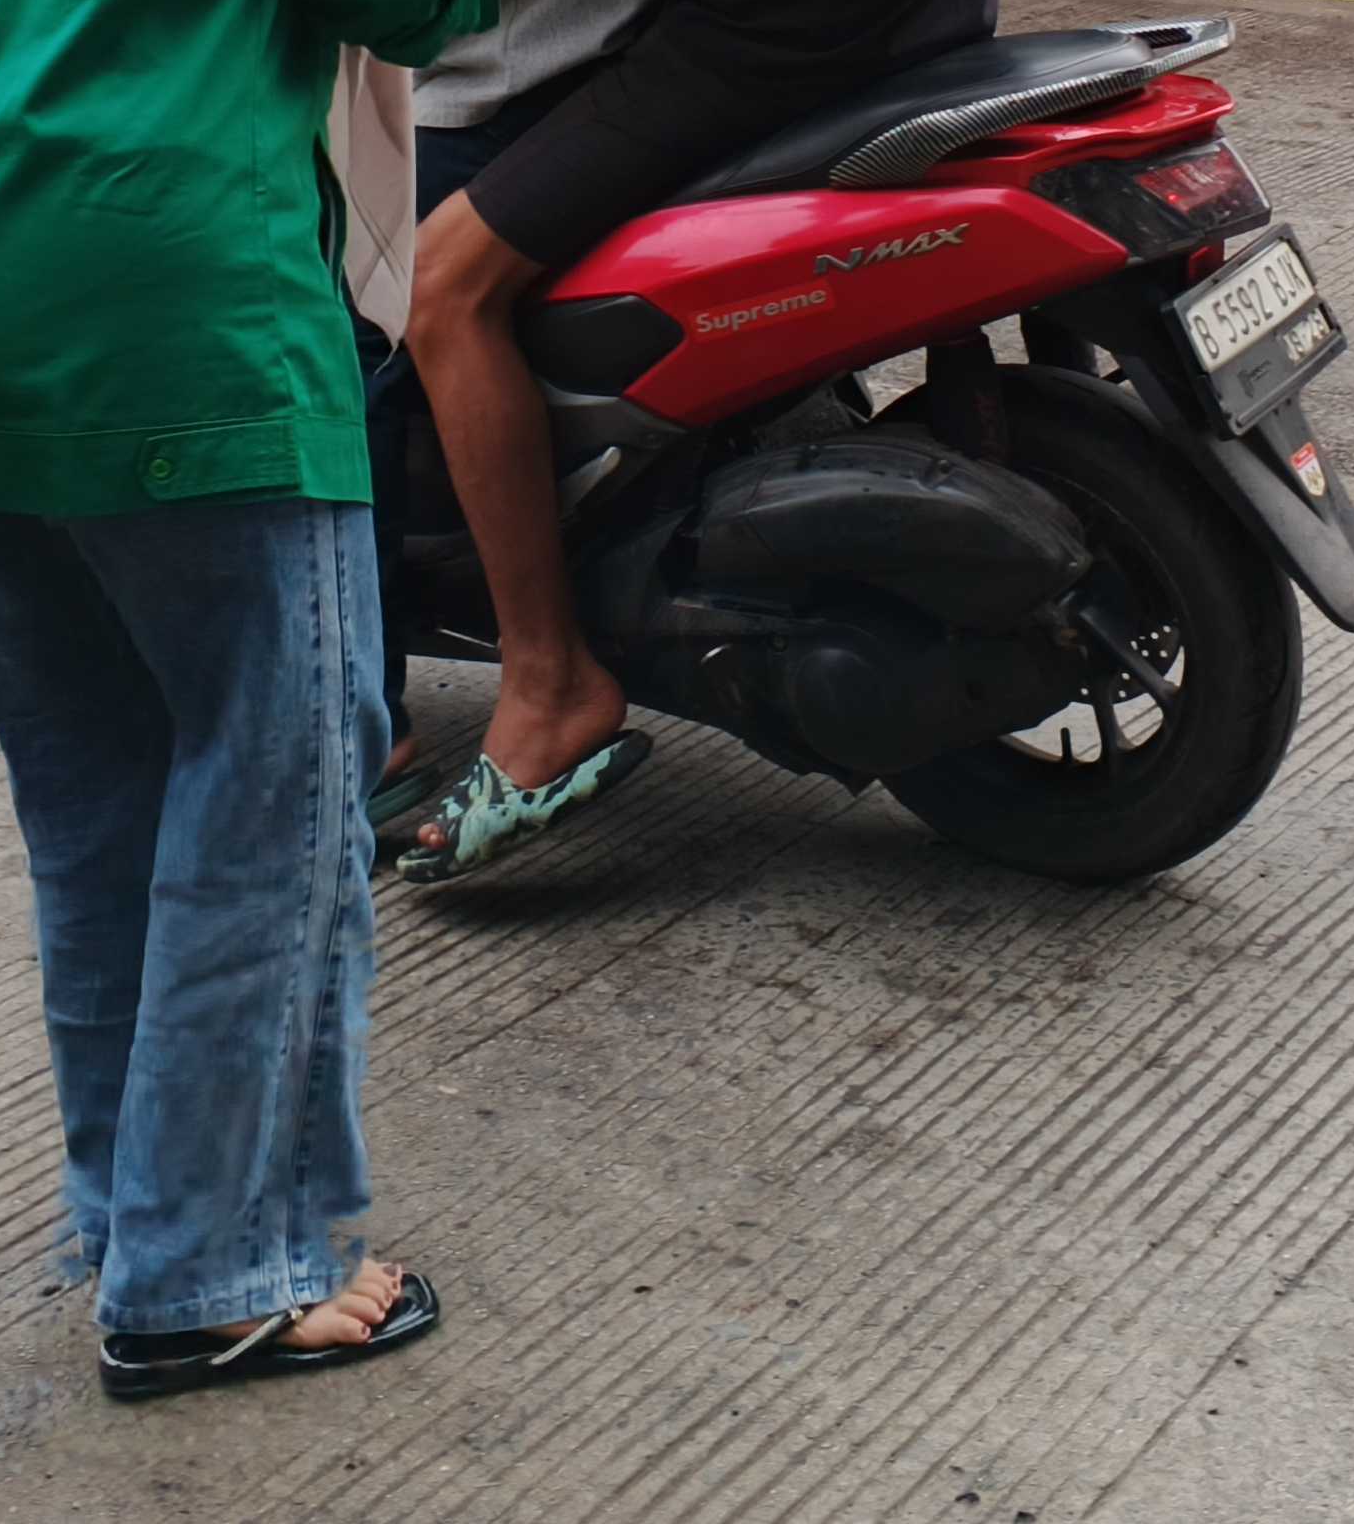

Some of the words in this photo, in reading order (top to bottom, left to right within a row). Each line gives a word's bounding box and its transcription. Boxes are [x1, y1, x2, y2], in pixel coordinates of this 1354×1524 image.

[813, 222, 970, 275] NMAX
[696, 288, 828, 335] Supreme
[1193, 313, 1220, 360] B
[1211, 277, 1274, 344] 5592
[1264, 251, 1307, 307] BJK
